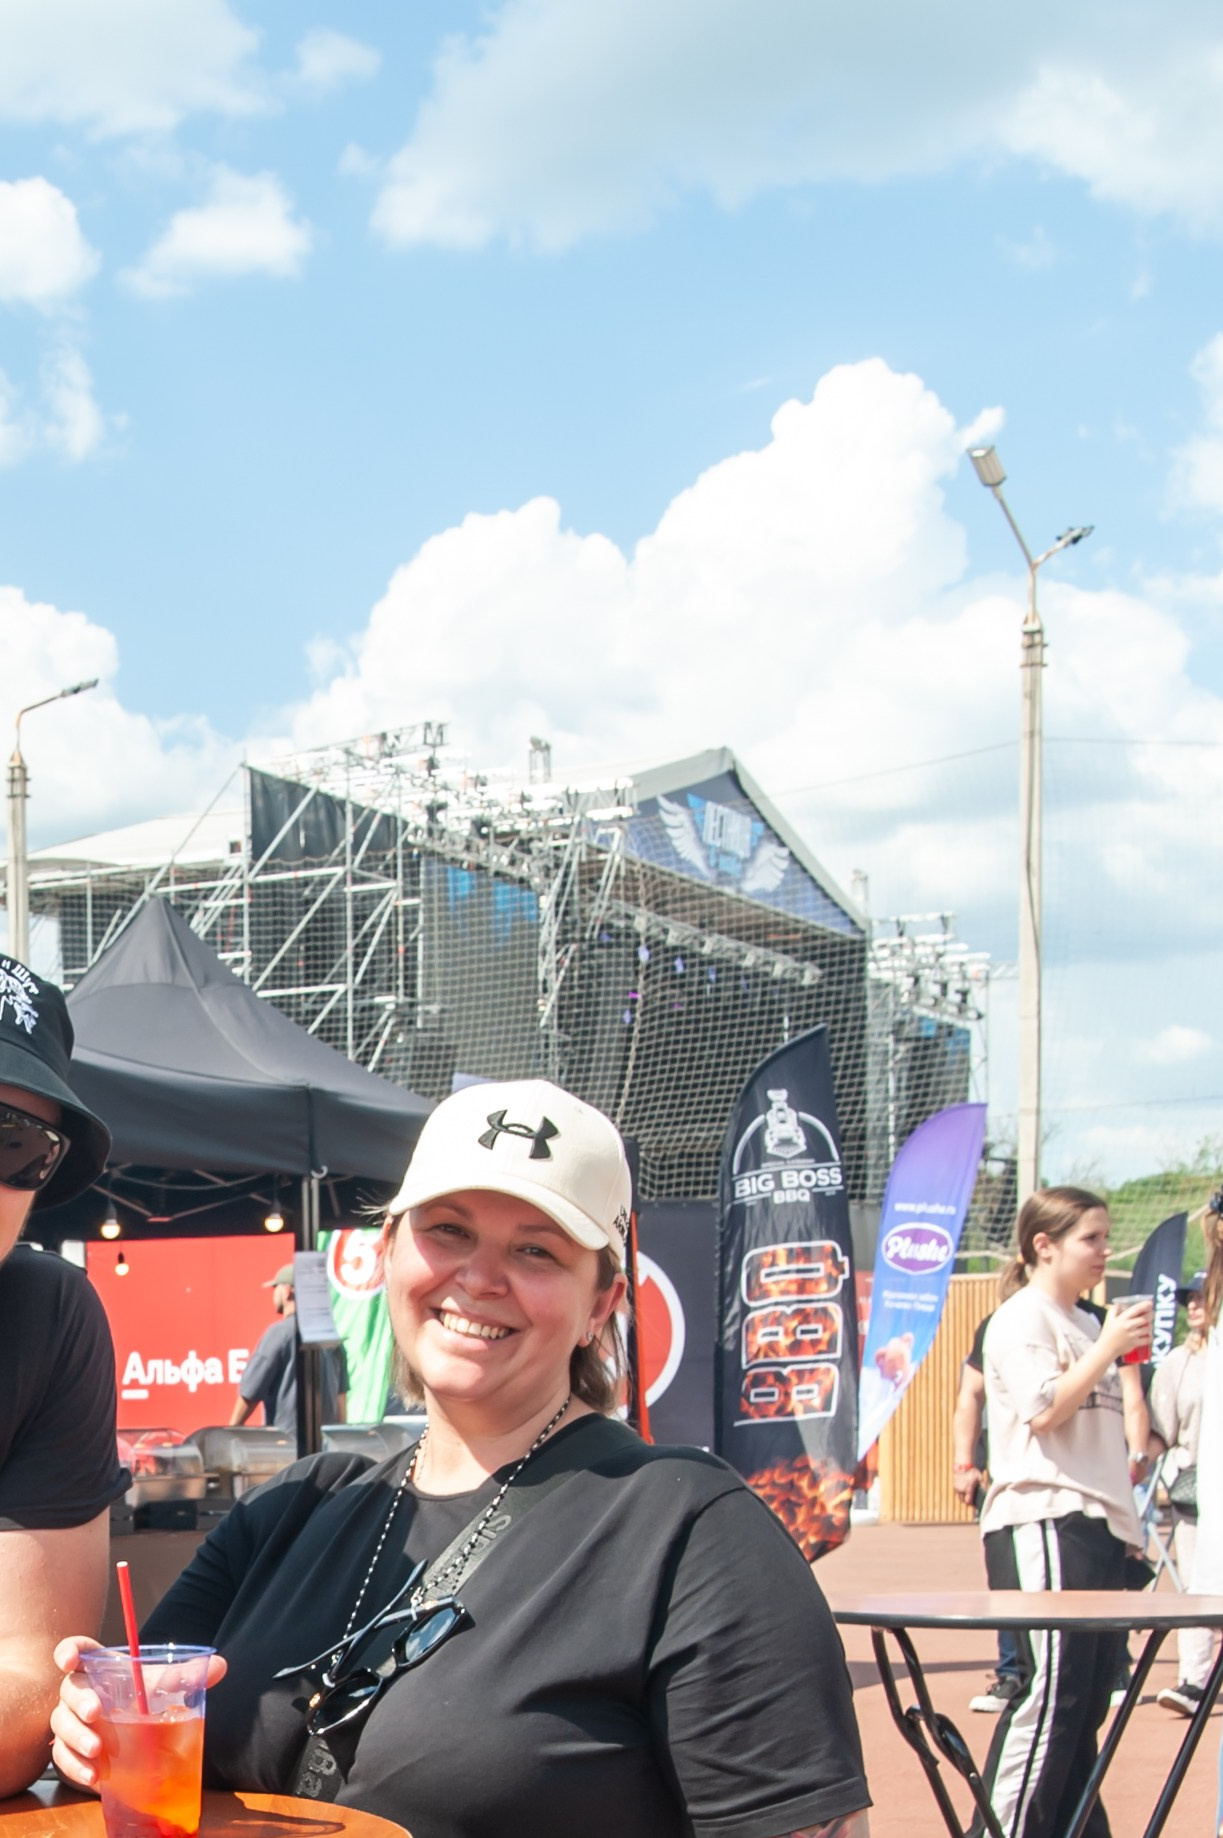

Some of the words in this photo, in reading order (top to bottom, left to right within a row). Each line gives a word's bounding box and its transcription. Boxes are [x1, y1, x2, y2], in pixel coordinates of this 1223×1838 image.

[735, 1174, 775, 1198] BIG
[781, 1167, 842, 1189] BOSS
[733, 1239, 850, 1427] BBQ
[121, 1350, 225, 1393] Альфа
